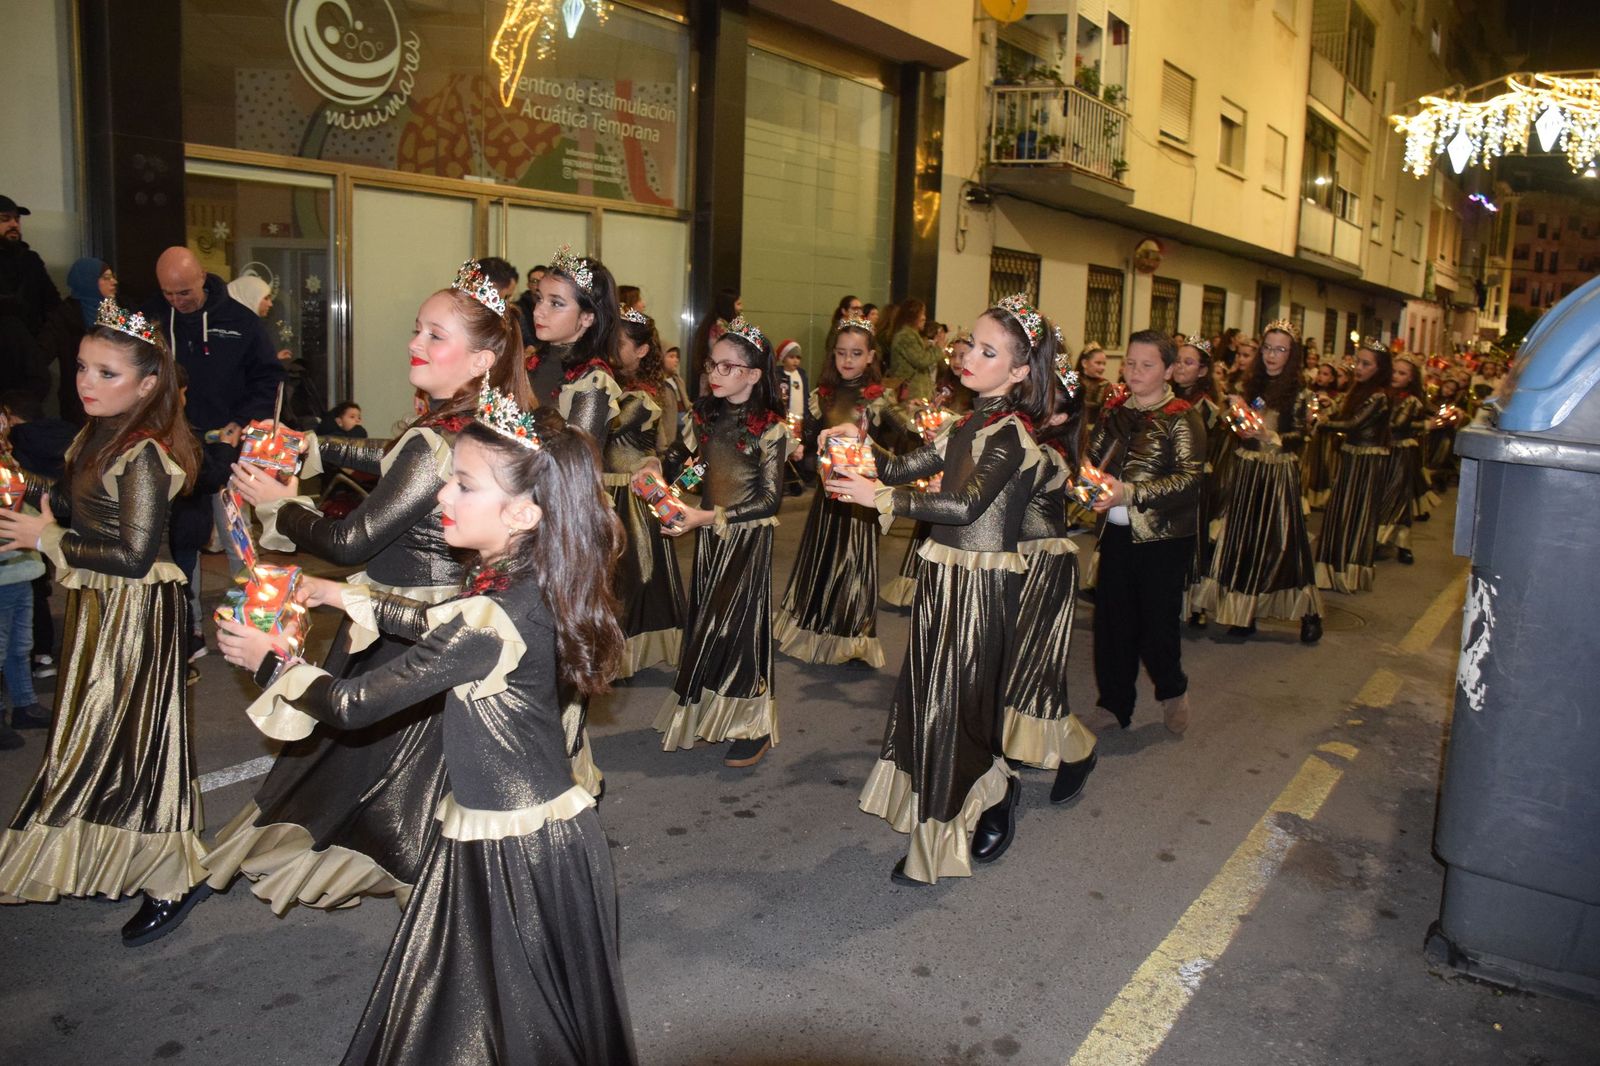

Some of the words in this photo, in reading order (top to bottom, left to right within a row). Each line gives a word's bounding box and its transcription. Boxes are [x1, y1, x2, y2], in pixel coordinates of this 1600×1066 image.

[325, 30, 420, 130] minimares
[520, 98, 588, 129] Acuática
[591, 112, 660, 142] Temprana
[566, 82, 584, 102] de
[589, 87, 676, 123] Estimulación
